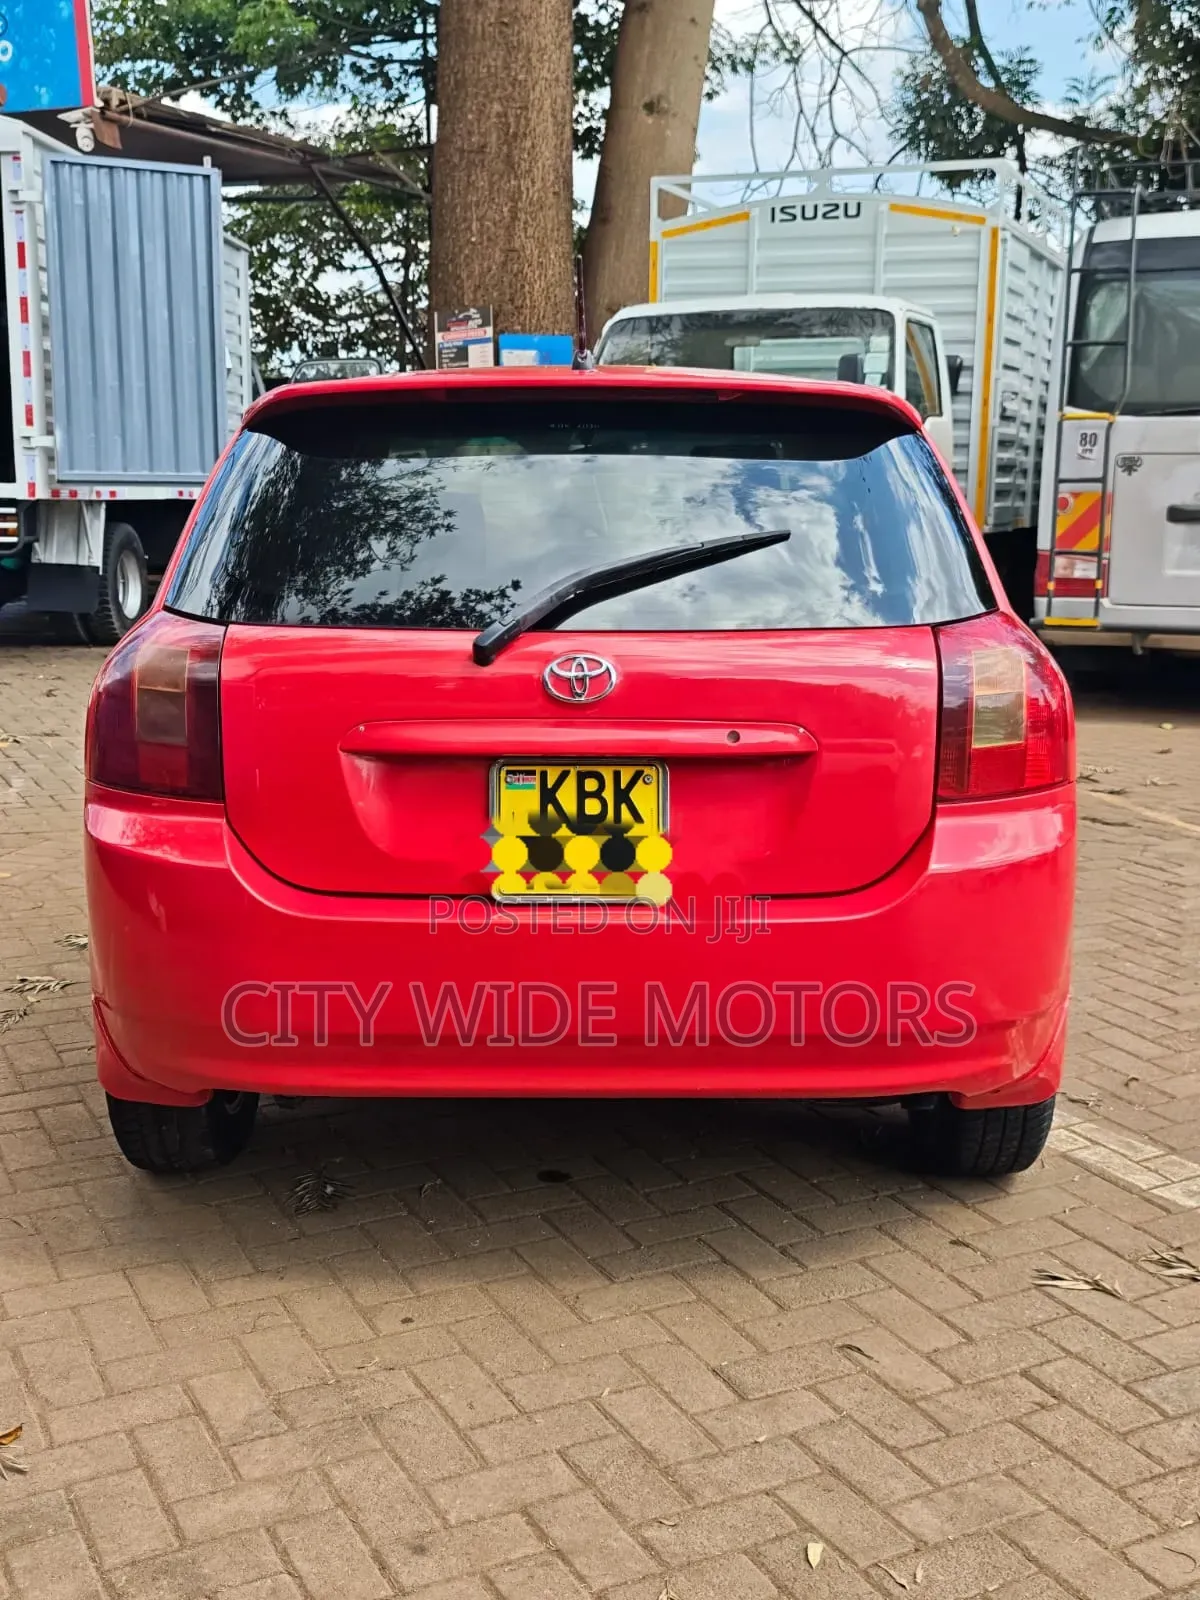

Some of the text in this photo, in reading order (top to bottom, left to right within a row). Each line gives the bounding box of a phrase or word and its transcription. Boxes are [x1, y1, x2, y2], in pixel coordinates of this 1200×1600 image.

[770, 202, 861, 223] ISUZU
[1079, 432, 1098, 447] 80
[539, 769, 645, 824] KBK
